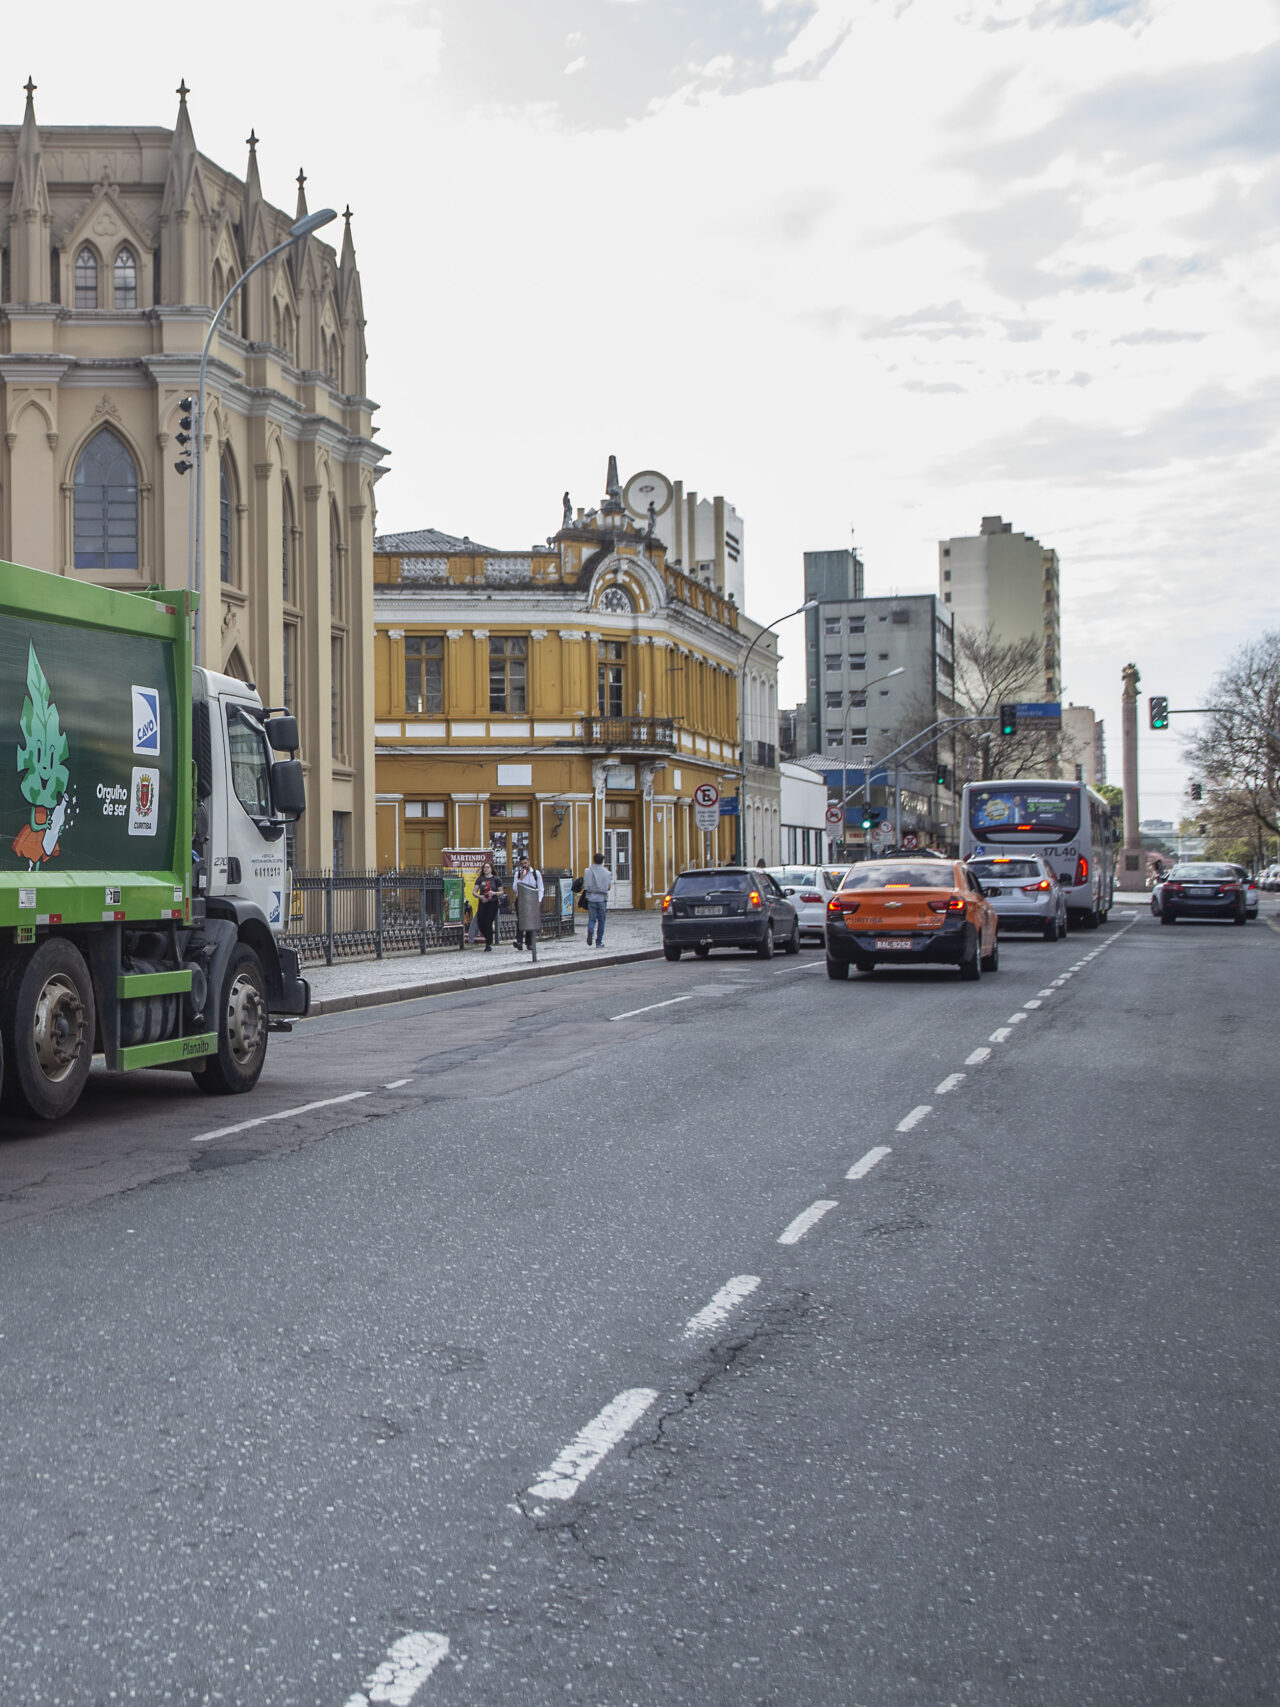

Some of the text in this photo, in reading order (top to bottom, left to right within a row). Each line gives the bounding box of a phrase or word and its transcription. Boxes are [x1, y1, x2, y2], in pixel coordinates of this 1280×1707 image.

[137, 719, 155, 741] CAVO
[96, 783, 128, 802] Orgulho
[103, 801, 128, 817] de ser
[133, 821, 152, 830] CURITIBA
[450, 854, 486, 862] MARTINHO
